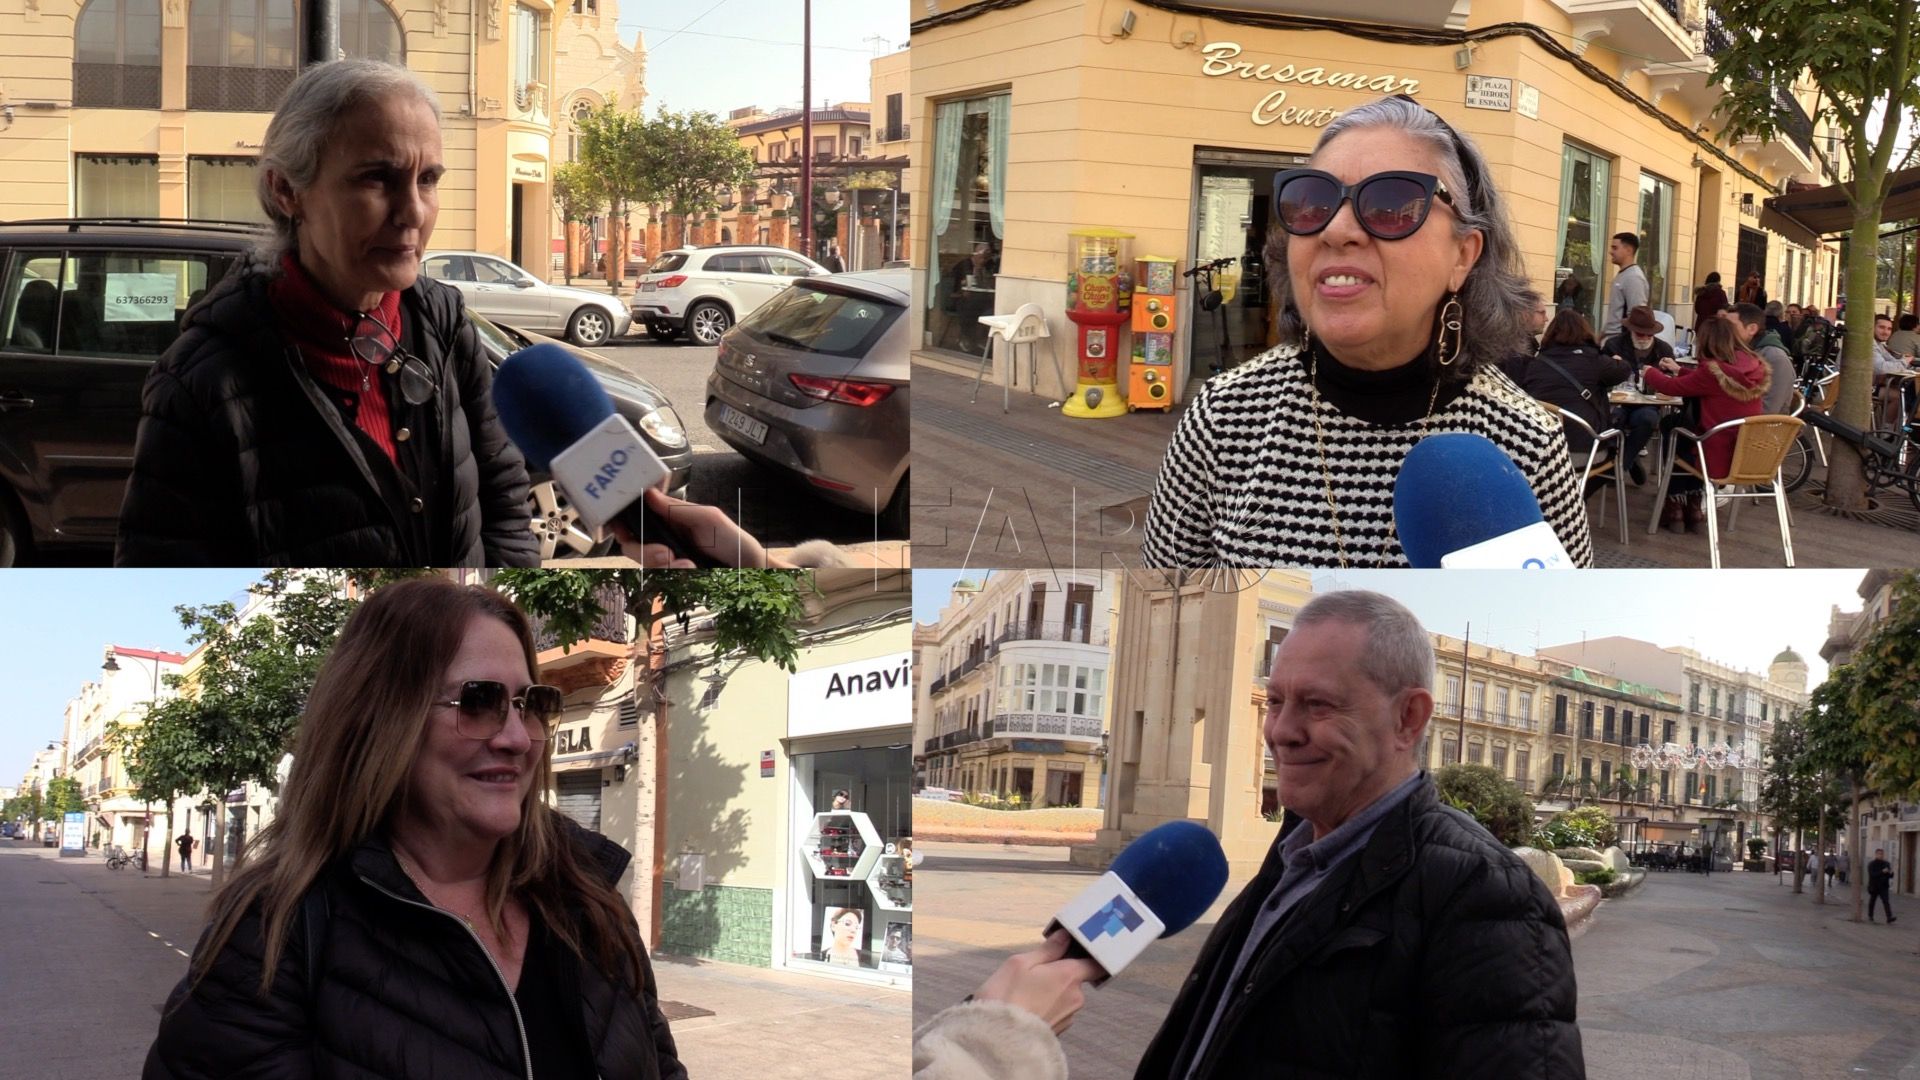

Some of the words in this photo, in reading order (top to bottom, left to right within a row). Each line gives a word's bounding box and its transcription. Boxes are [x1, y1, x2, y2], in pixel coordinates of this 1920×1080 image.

[1485, 82, 1508, 90] PLAZA
[1480, 90, 1509, 99] HEROES
[115, 295, 168, 304] 637366293
[745, 420, 767, 440] JLT
[584, 449, 628, 499] FARO
[825, 658, 912, 699] Anavi
